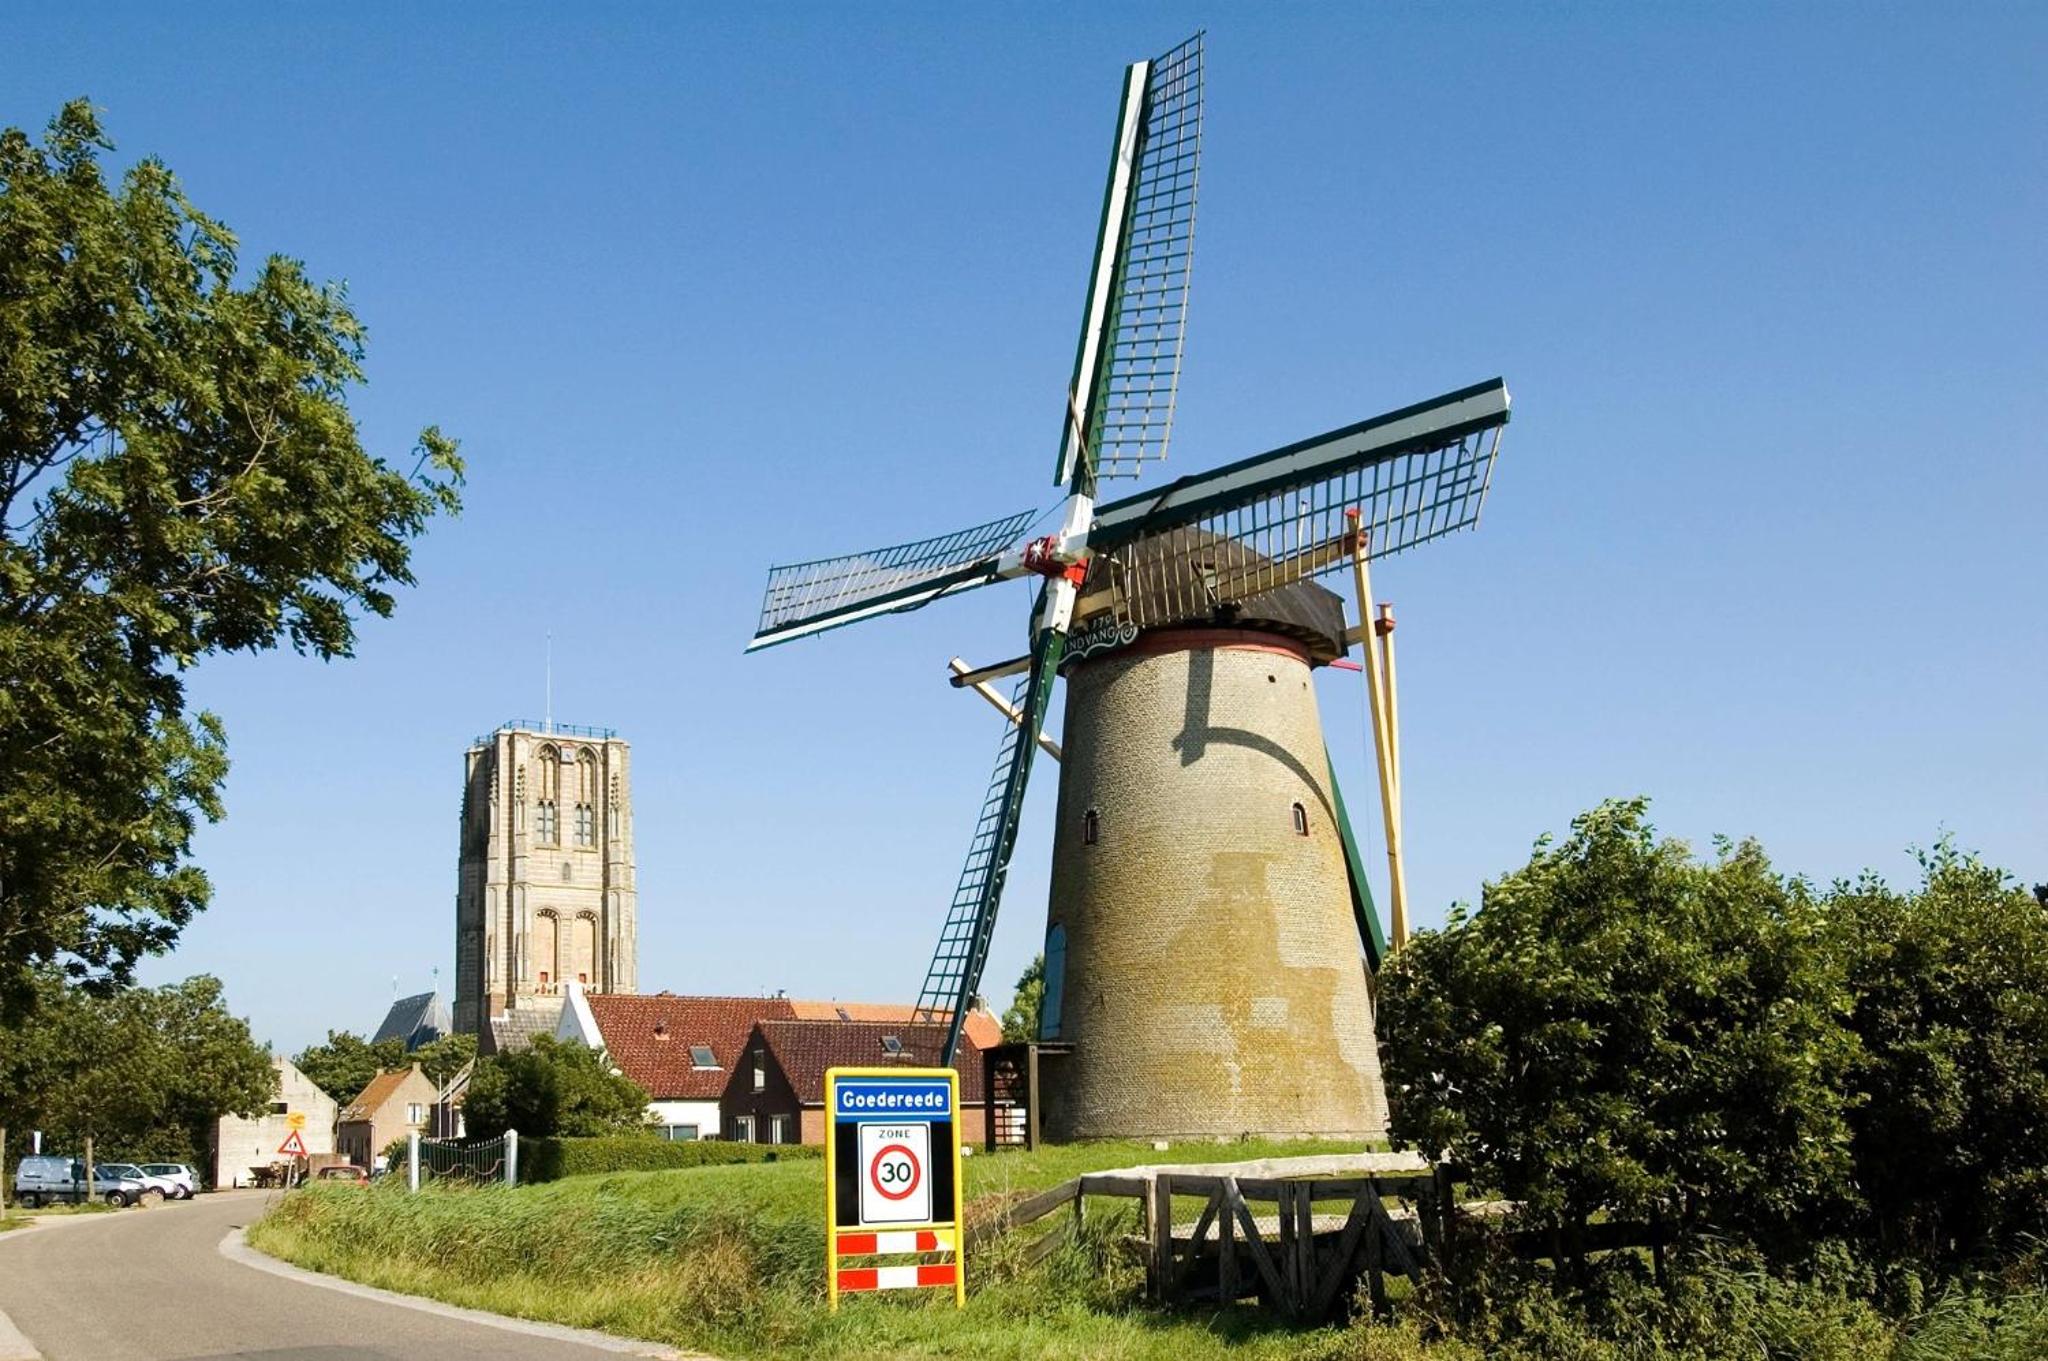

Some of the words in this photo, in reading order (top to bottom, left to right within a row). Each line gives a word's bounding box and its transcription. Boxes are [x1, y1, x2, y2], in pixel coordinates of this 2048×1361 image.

[1064, 625, 1115, 654] INDVANG
[842, 1090, 944, 1108] Goedereede
[878, 1129, 911, 1139] ZONE
[881, 1162, 911, 1183] 30
